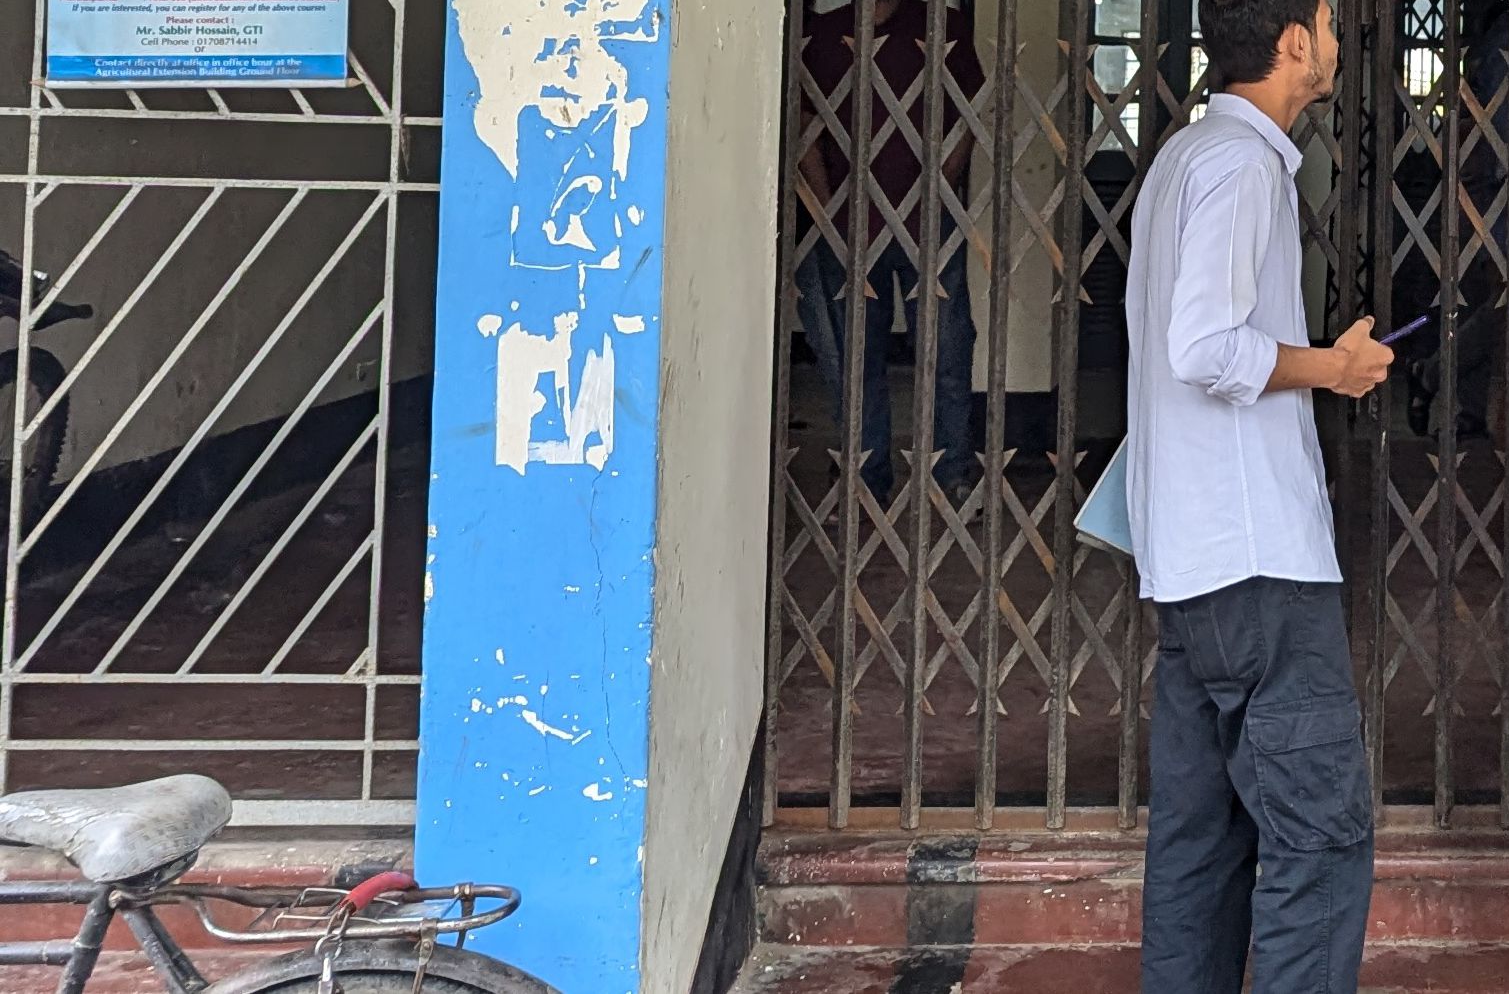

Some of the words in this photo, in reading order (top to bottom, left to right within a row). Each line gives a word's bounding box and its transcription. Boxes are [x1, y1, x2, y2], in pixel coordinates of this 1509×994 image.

[165, 15, 193, 24] Please
[195, 16, 229, 24] contact
[135, 25, 155, 35] Mr.
[158, 25, 192, 35] Sabbir
[195, 25, 240, 35] Hossain,
[242, 25, 262, 34] GTI
[140, 37, 159, 46] Cell
[161, 37, 189, 46] Phone
[193, 45, 206, 53] or
